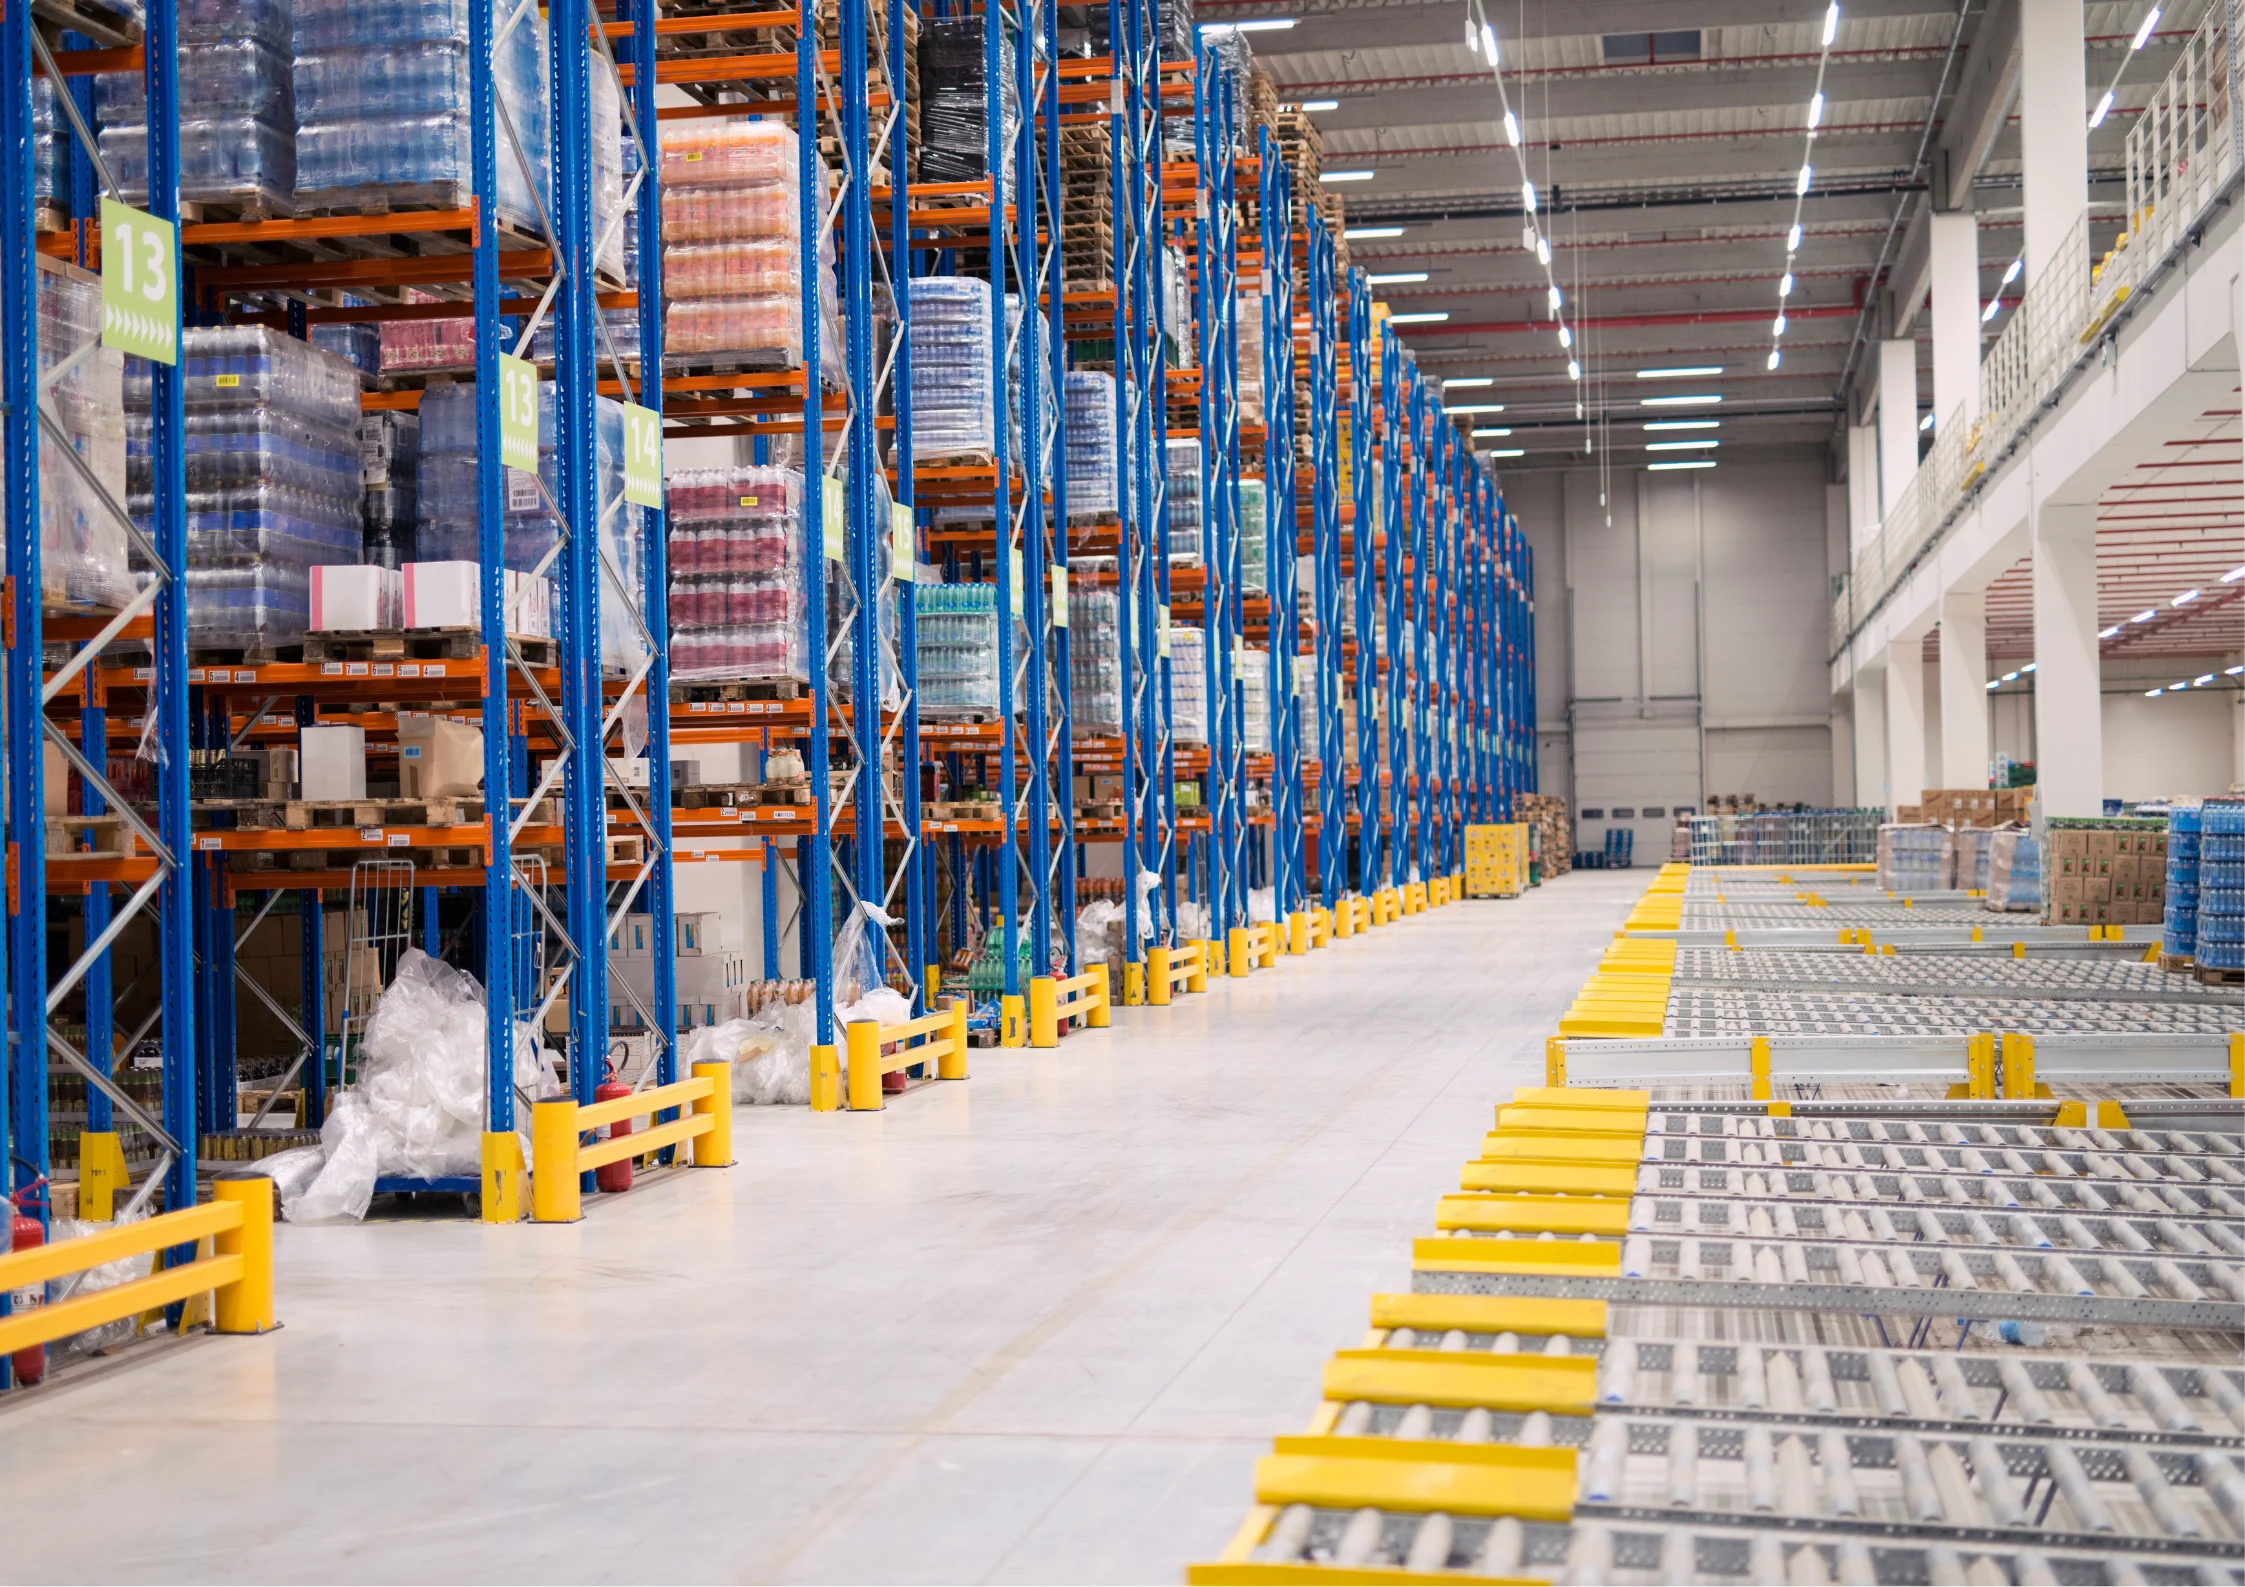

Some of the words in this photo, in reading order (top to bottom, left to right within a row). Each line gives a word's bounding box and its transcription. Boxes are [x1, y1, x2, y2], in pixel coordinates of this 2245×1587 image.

[115, 223, 167, 302] 13
[505, 368, 533, 428] 13
[630, 416, 657, 468] 14
[825, 485, 842, 528] 14
[896, 512, 911, 551] 15
[1011, 555, 1022, 589] 15
[1055, 572, 1066, 603] 16
